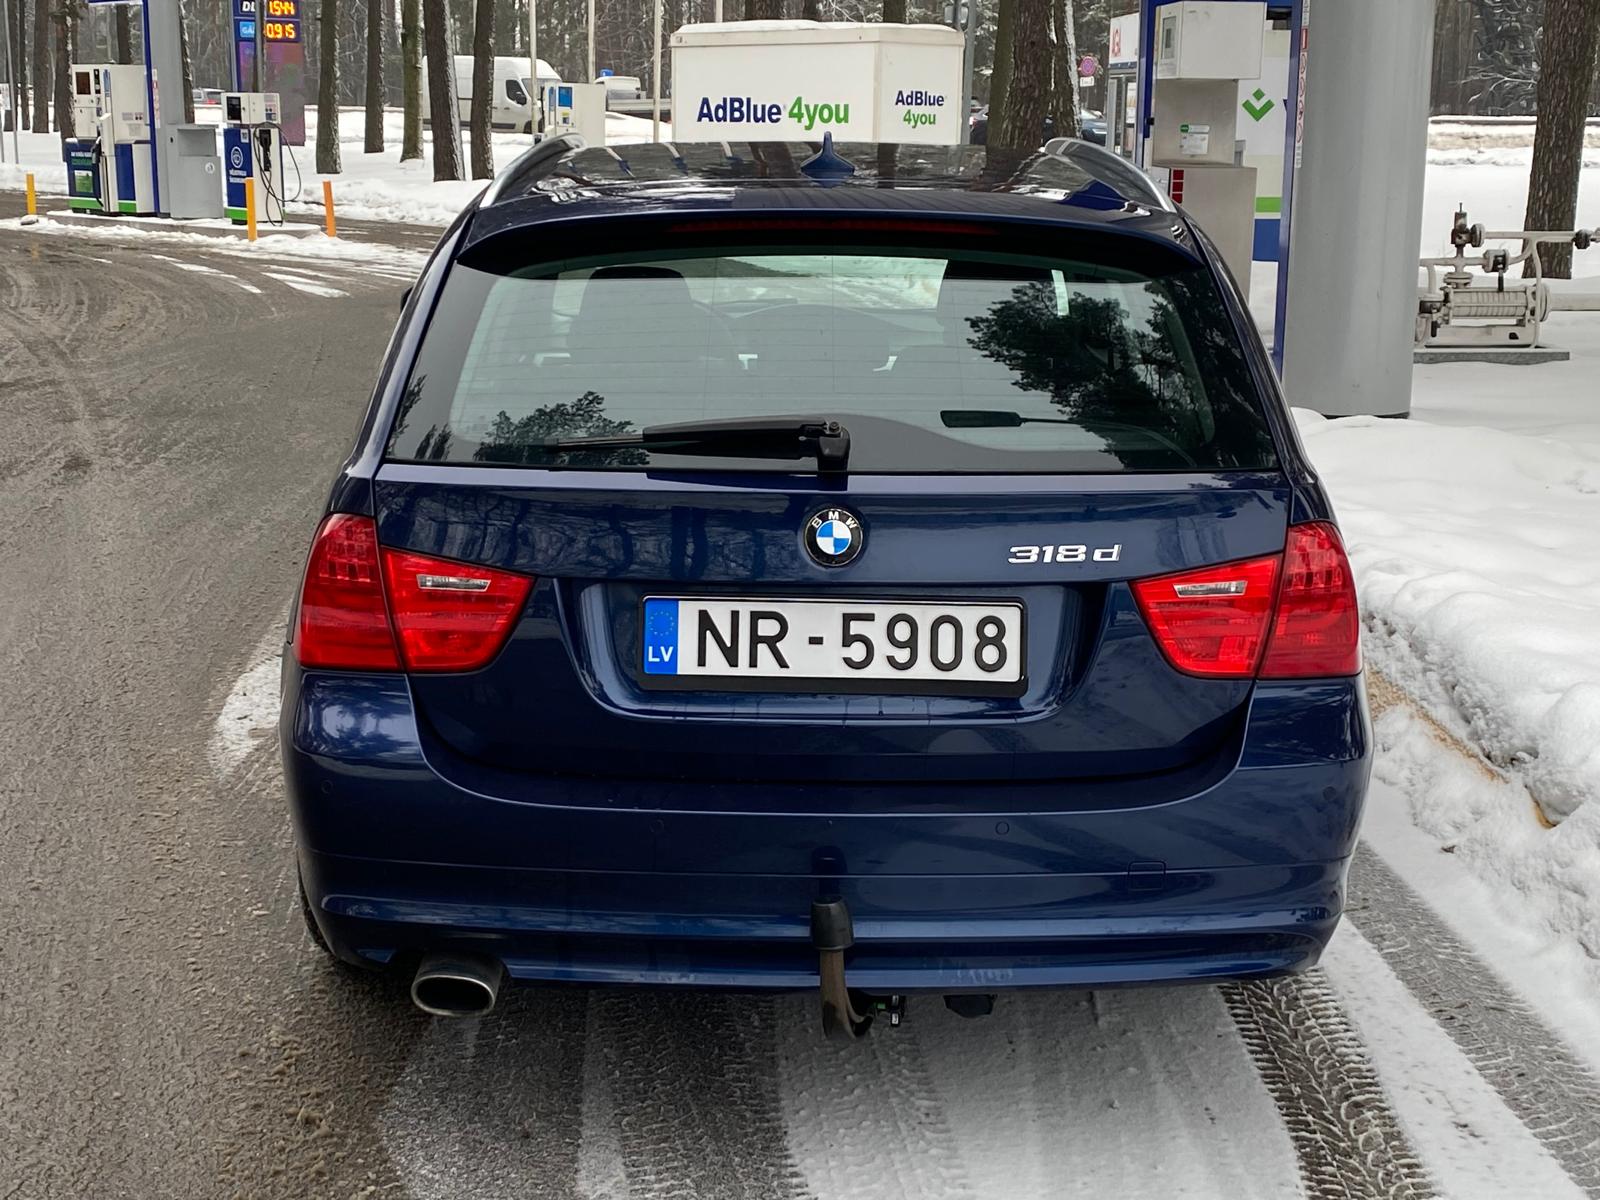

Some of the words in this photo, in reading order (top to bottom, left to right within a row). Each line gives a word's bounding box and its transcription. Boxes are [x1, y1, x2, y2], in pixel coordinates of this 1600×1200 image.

[895, 90, 945, 107] AdBlue
[697, 97, 782, 123] AdBlue
[788, 96, 849, 131] 4you
[903, 109, 936, 129] 4you
[811, 510, 858, 529] BMW
[648, 646, 674, 662] LV
